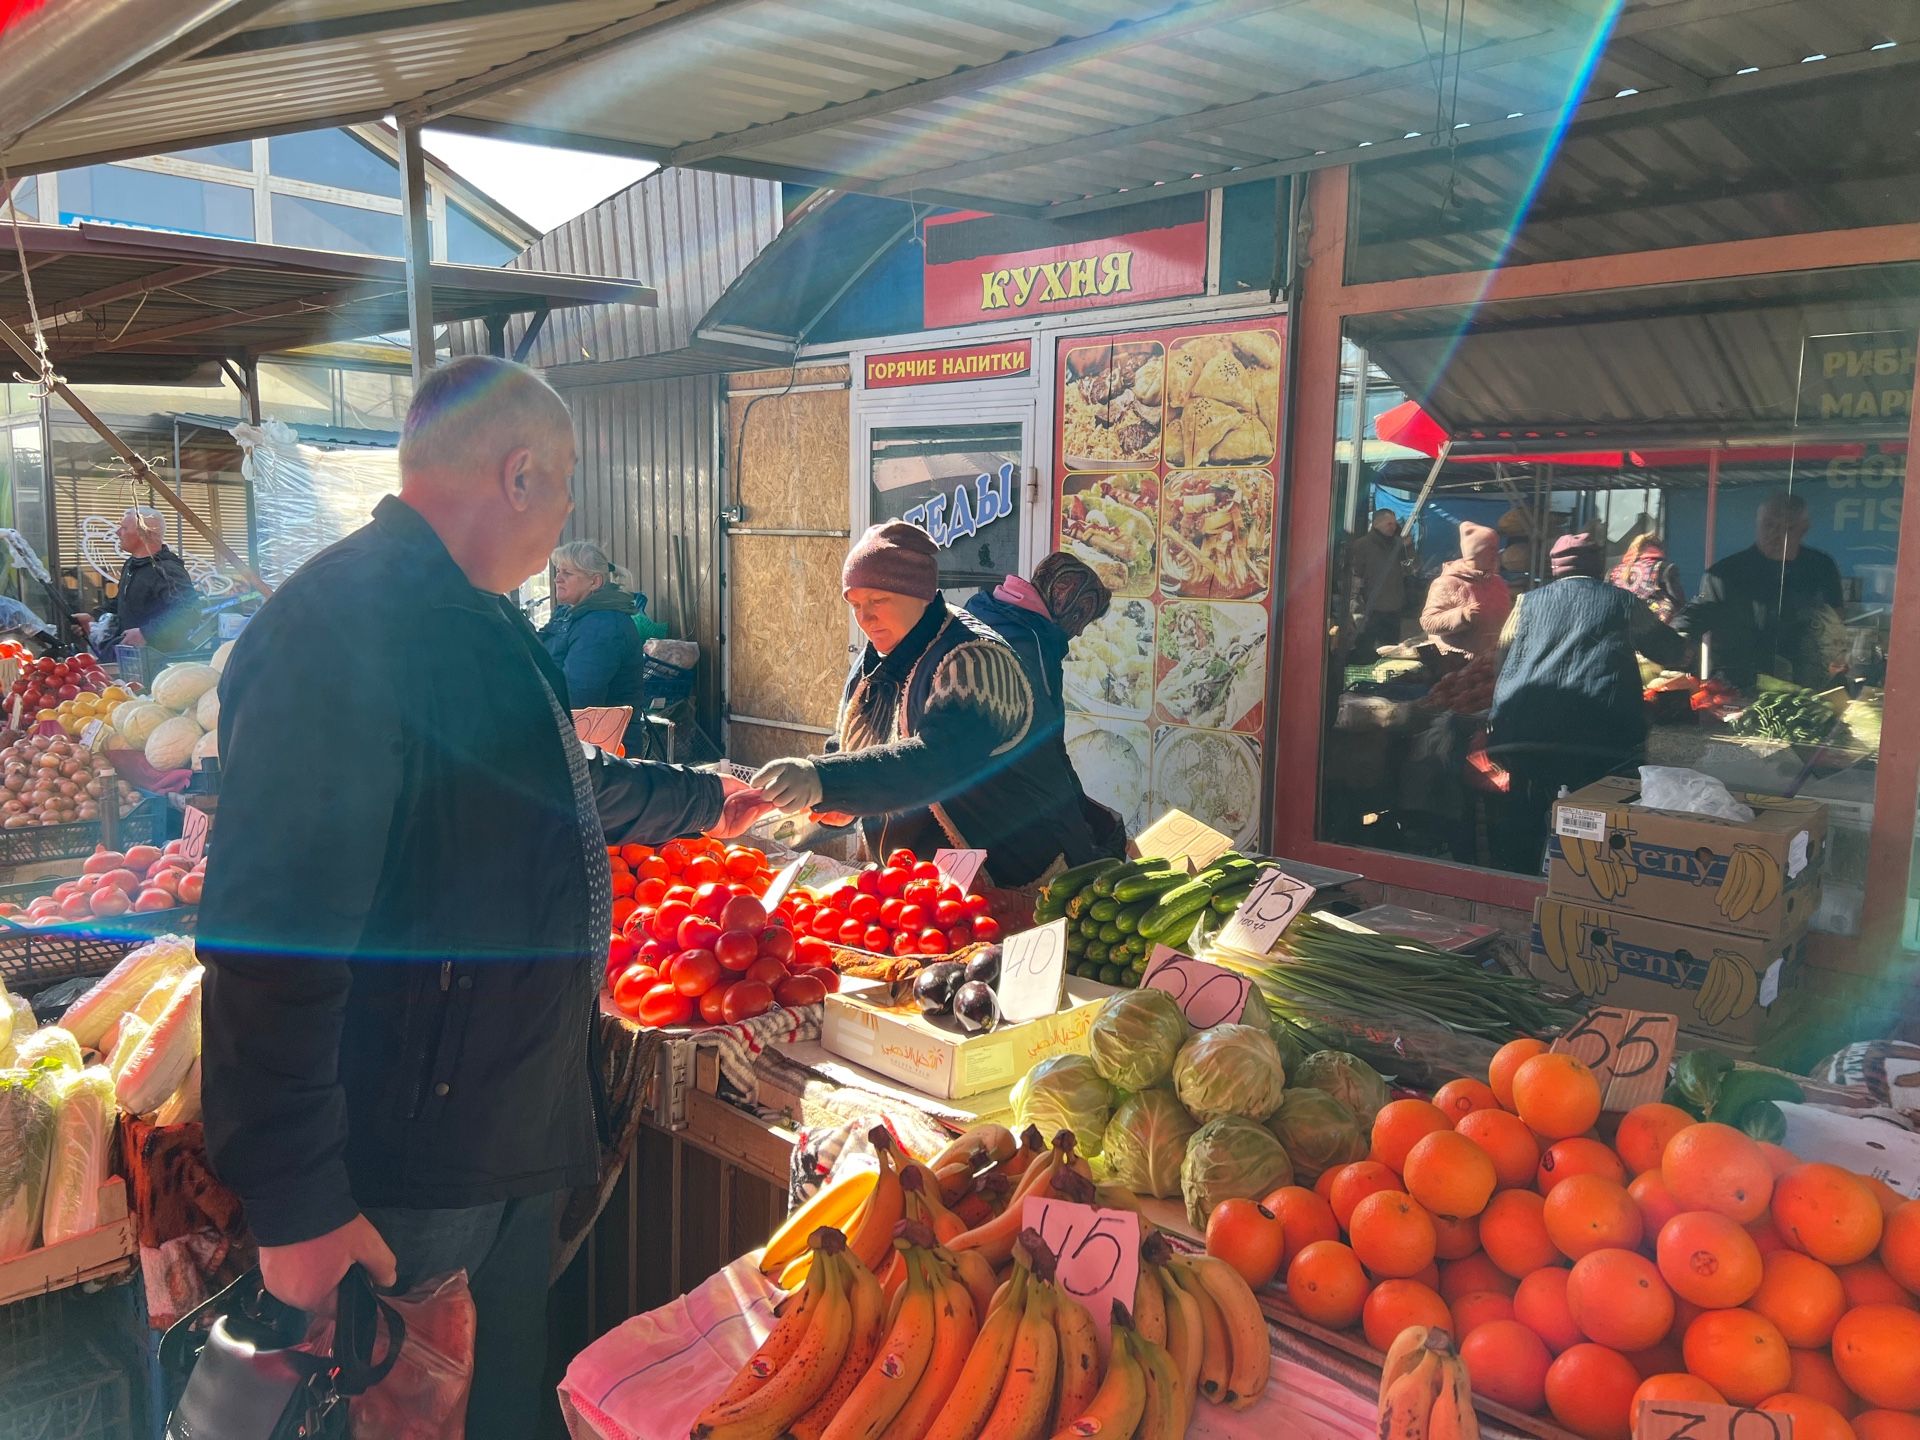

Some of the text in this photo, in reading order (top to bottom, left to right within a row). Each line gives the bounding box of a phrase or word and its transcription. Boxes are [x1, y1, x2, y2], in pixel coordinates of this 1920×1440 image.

[981, 251, 1134, 311] КУХНЯ
[868, 351, 1025, 380] ГОРЯЧИЕ НАПИТКИ
[888, 462, 1014, 548] ЕДЫ
[183, 808, 207, 858] 48
[1005, 928, 1057, 977] 40
[1566, 1010, 1670, 1078] 55
